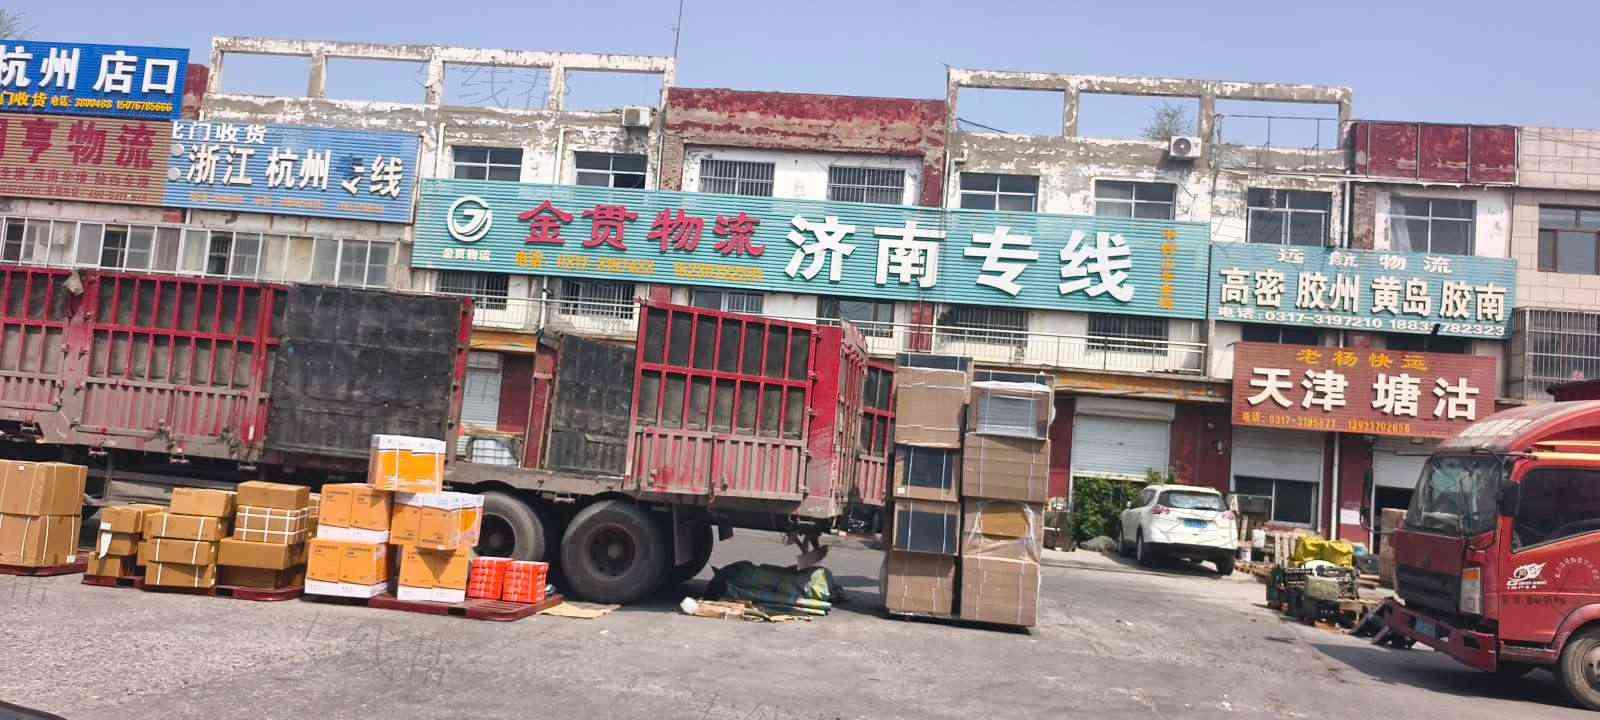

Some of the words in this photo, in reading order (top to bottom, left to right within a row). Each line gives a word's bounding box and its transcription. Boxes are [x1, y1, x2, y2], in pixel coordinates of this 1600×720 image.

[0, 45, 81, 90] 杭州
[92, 50, 179, 94] 店口
[186, 144, 256, 185] 浙江
[265, 147, 332, 190] 杭州
[517, 200, 766, 257] 金贯物流
[784, 214, 1136, 302] 济南专线
[1219, 266, 1284, 308] 高密
[1295, 271, 1361, 313] 胶州
[1370, 275, 1431, 317] 黄岛
[1438, 279, 1507, 322] 胶南
[1296, 348, 1428, 372] 老杨快运
[1247, 367, 1349, 412] 天津
[1371, 372, 1480, 421] 塘沽
